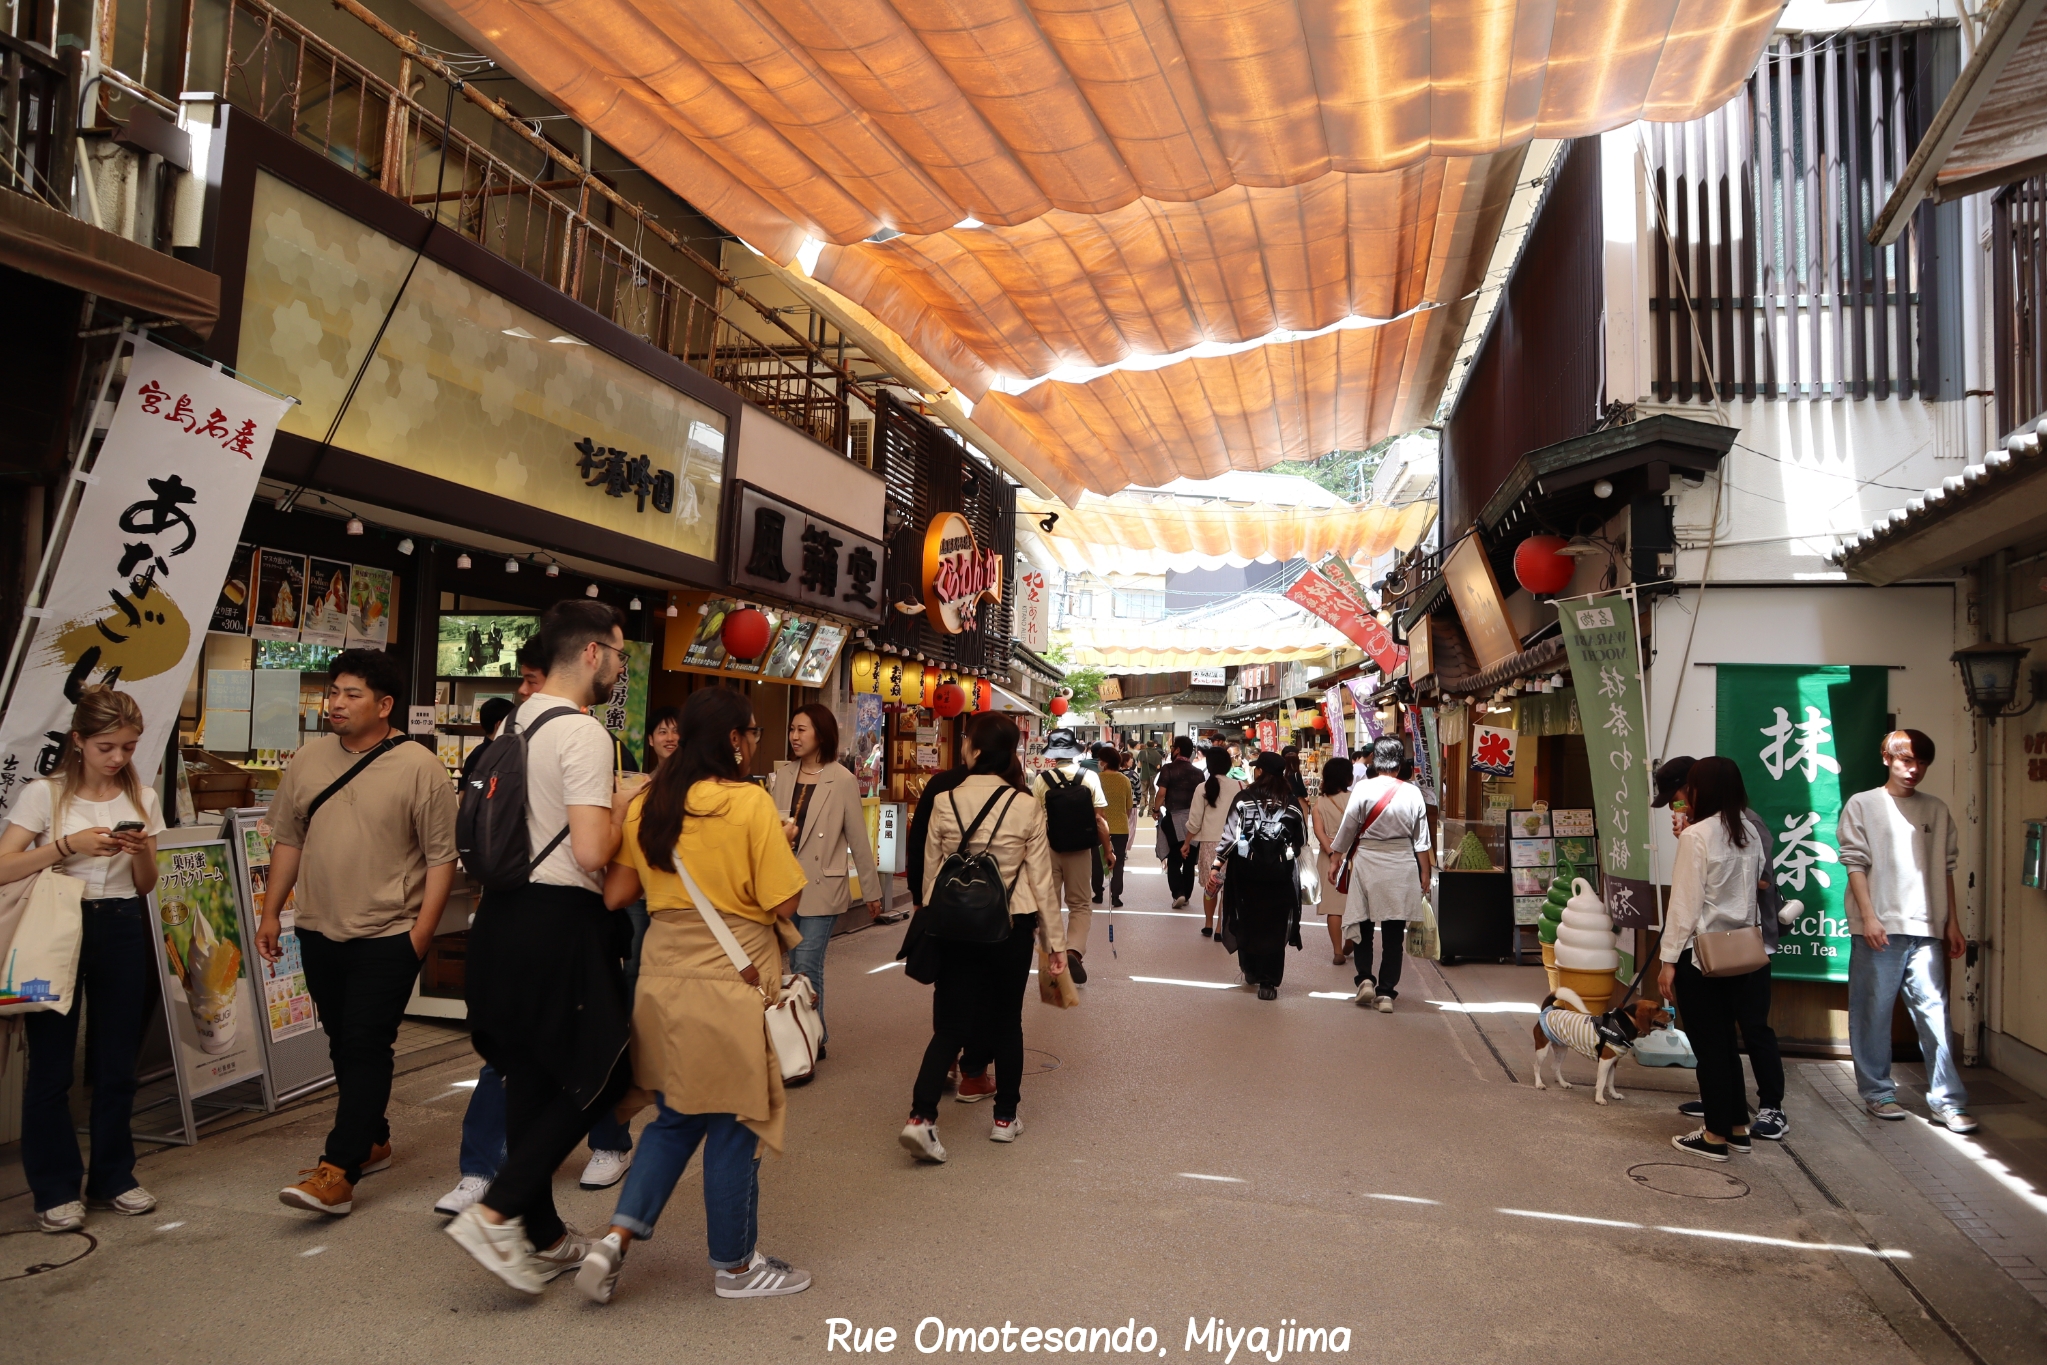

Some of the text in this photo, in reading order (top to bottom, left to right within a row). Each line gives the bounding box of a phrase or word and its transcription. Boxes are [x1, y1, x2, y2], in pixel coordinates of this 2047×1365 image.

[138, 380, 259, 460] 宮島名産
[1477, 733, 1511, 767] 氷
[1759, 705, 1842, 892] 抹茶
[161, 867, 224, 891] ソフトクリーム
[1776, 942, 1838, 957] een Tea
